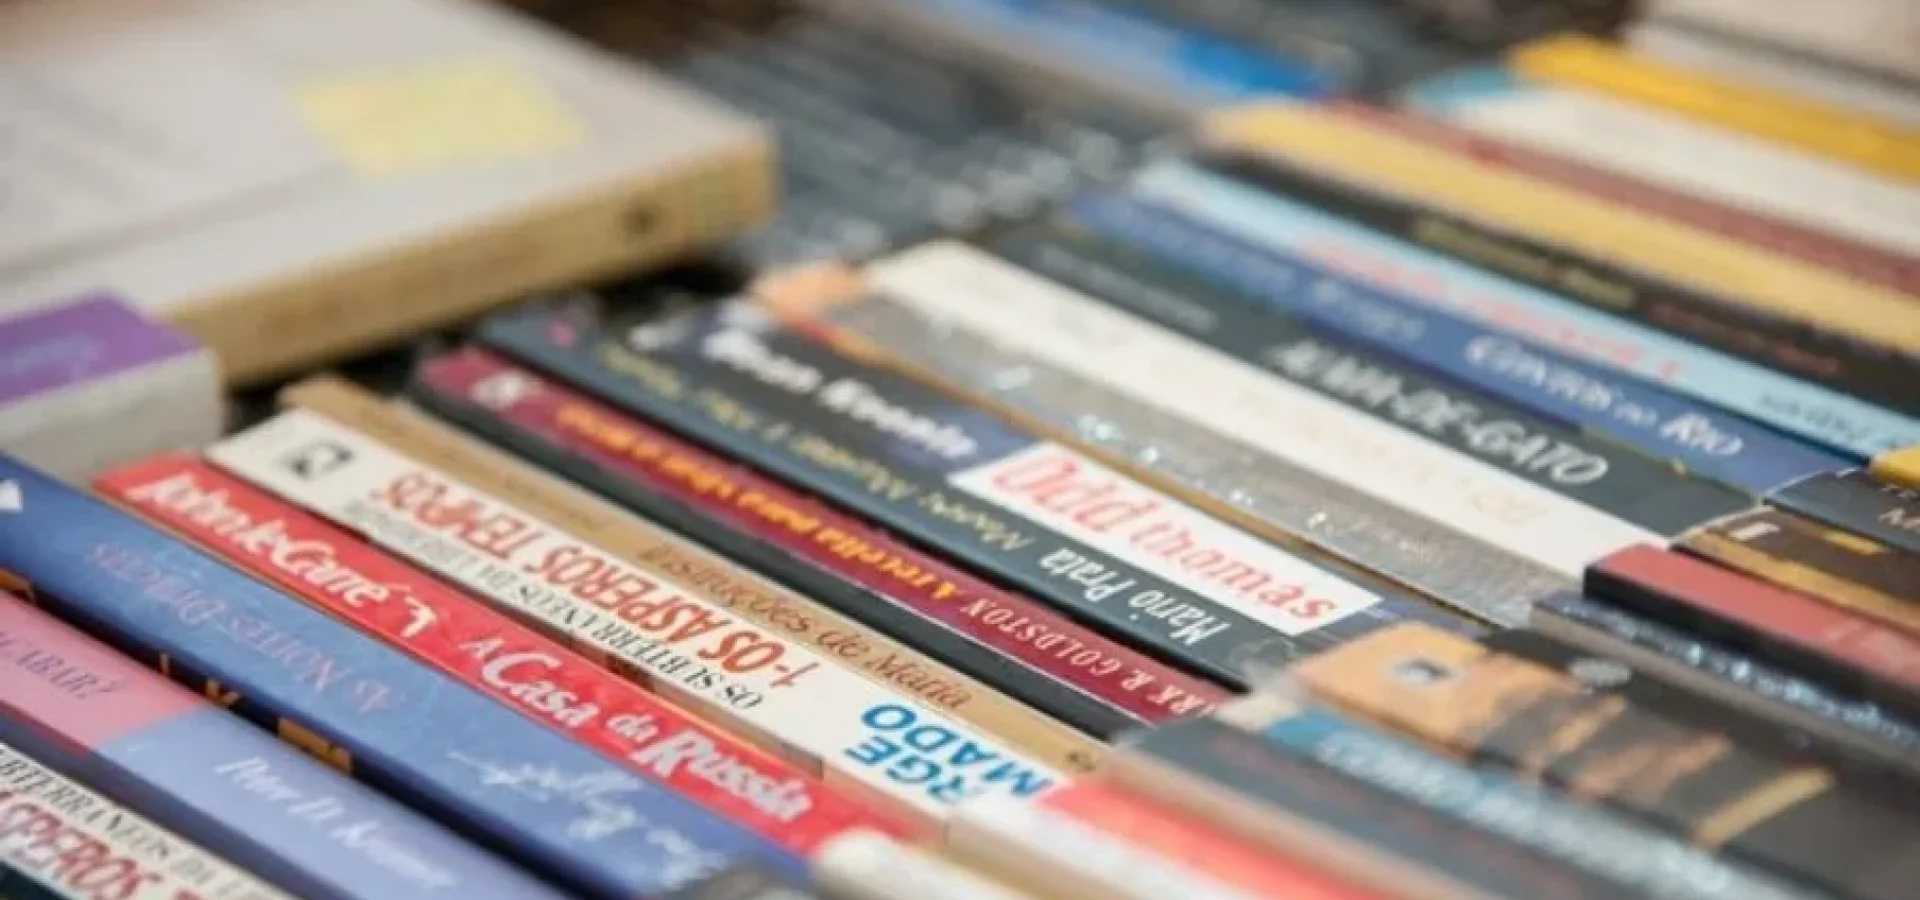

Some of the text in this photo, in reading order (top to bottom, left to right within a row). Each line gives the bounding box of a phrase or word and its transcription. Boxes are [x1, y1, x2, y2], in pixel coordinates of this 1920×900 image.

[992, 460, 1160, 533] Odd
[961, 596, 1122, 677] GOLDSTON
[1038, 547, 1232, 646] Mario Prata
[480, 652, 600, 729] Casa
[606, 712, 659, 743] da
